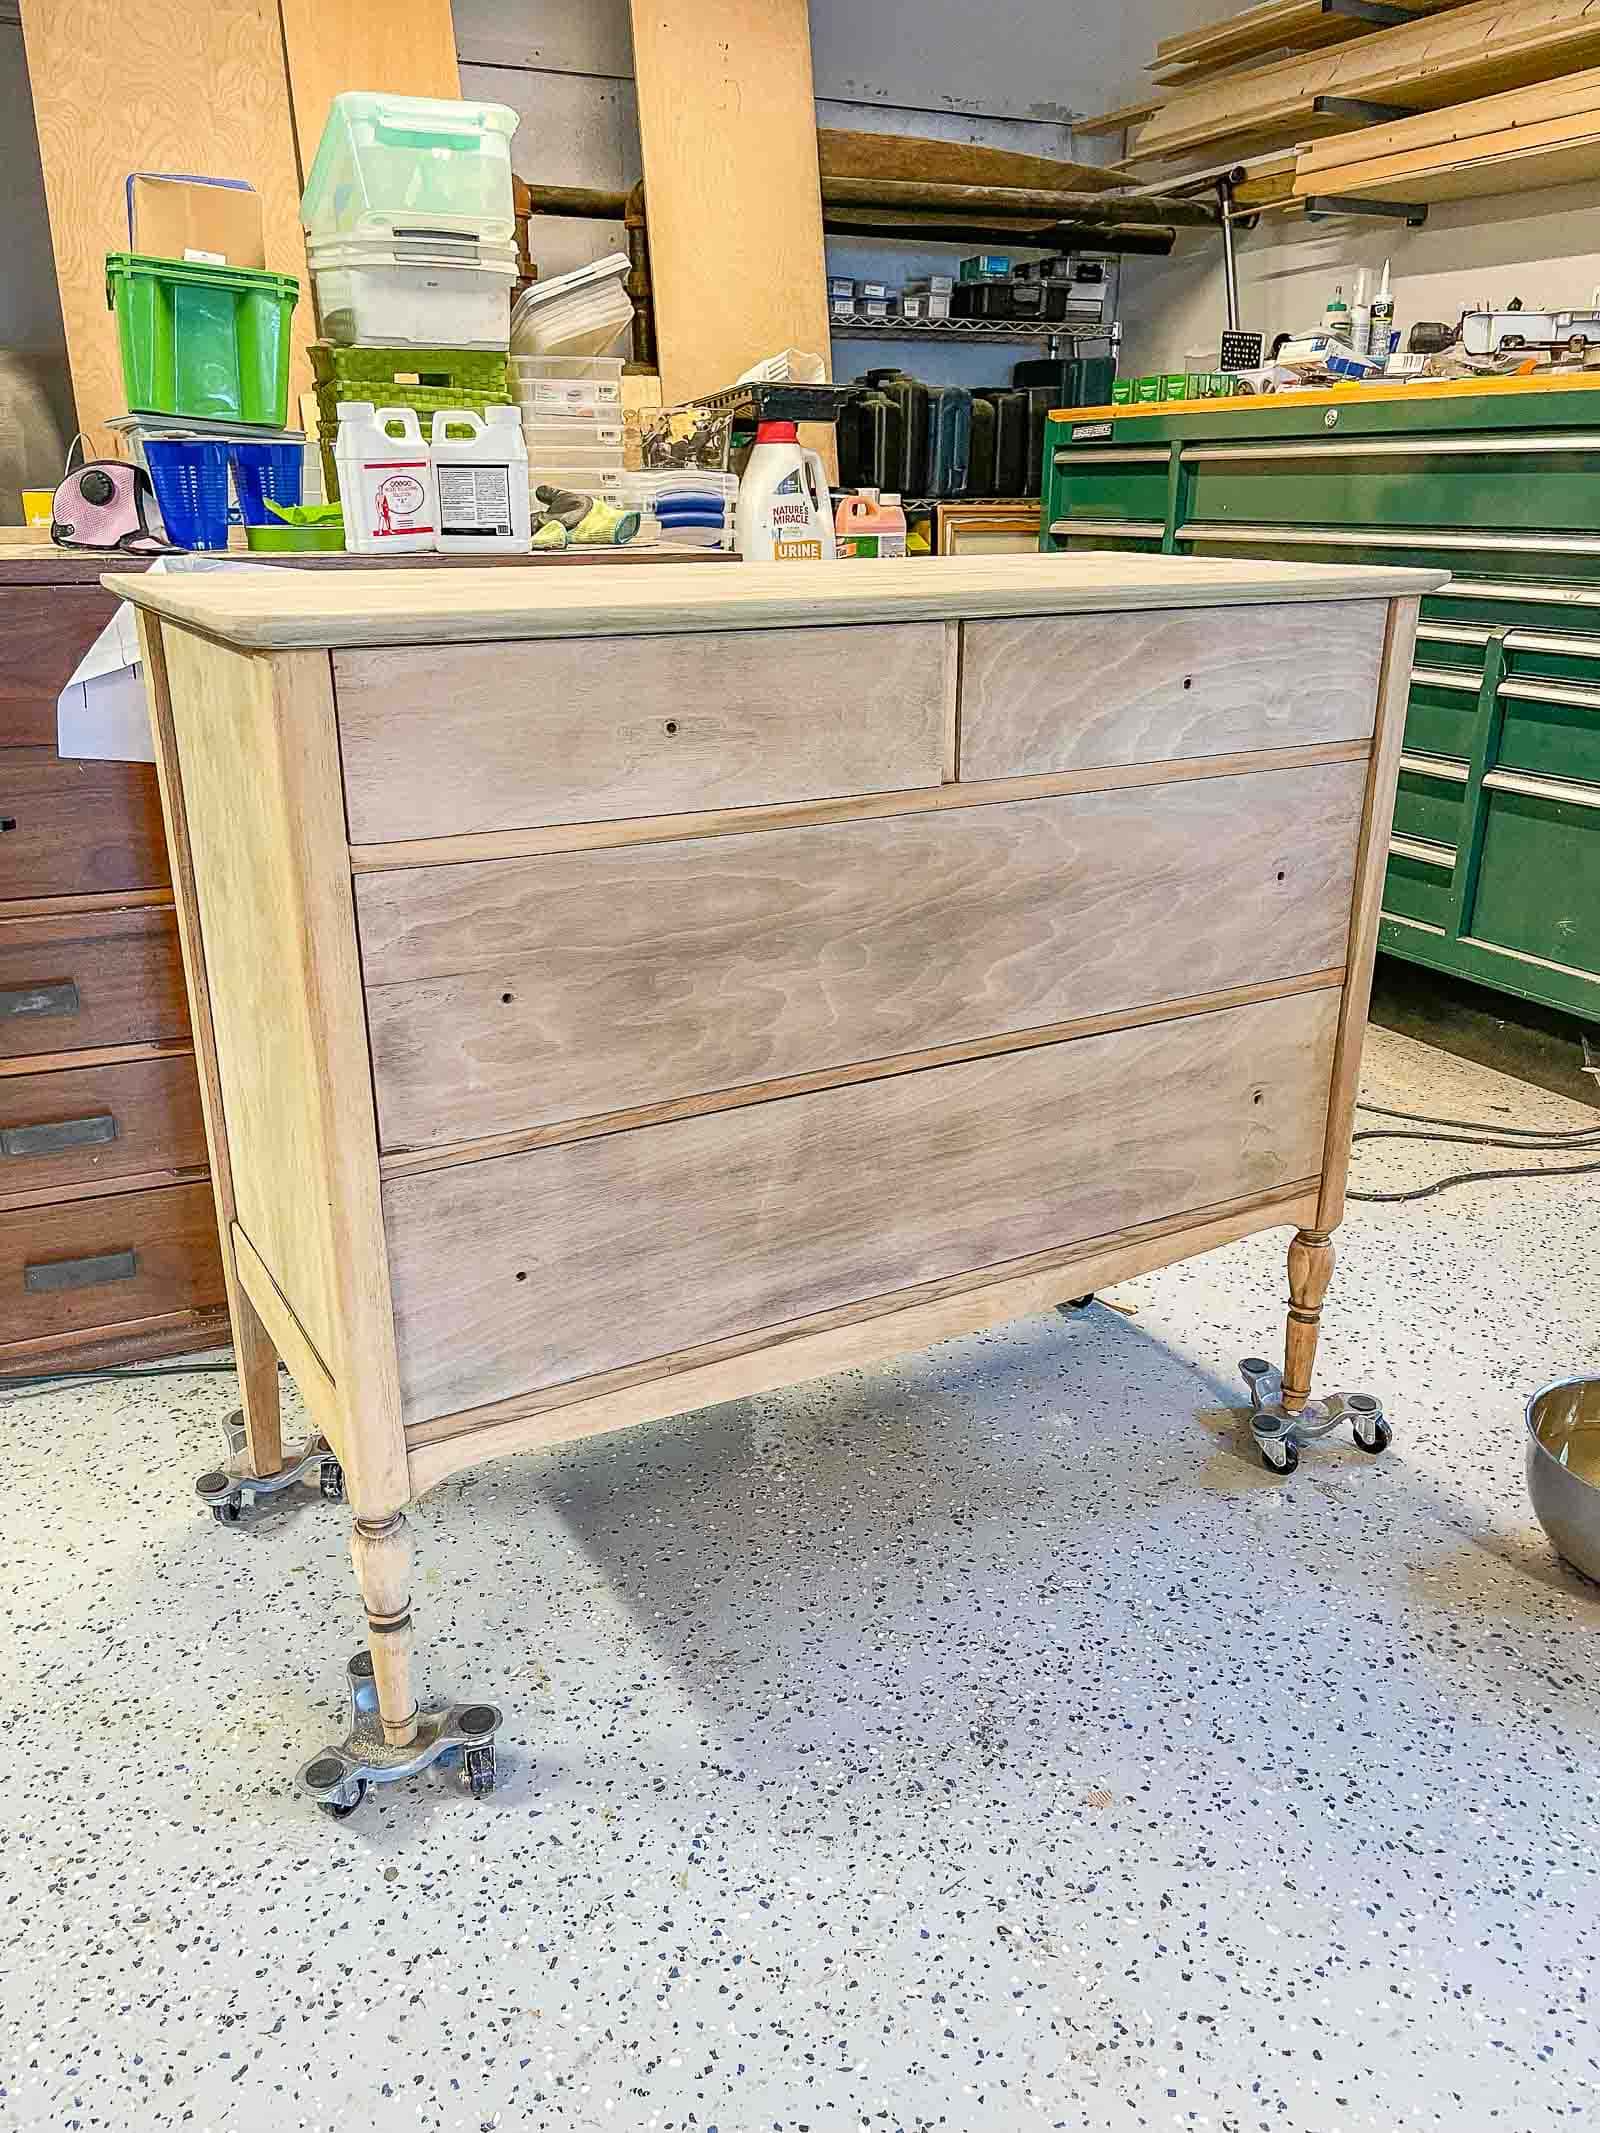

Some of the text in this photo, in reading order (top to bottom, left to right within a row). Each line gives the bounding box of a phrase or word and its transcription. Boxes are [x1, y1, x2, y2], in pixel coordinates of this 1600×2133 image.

[773, 501, 808, 515] NATURE'S
[773, 514, 808, 526] MIRACLE
[779, 543, 818, 558] URINE
